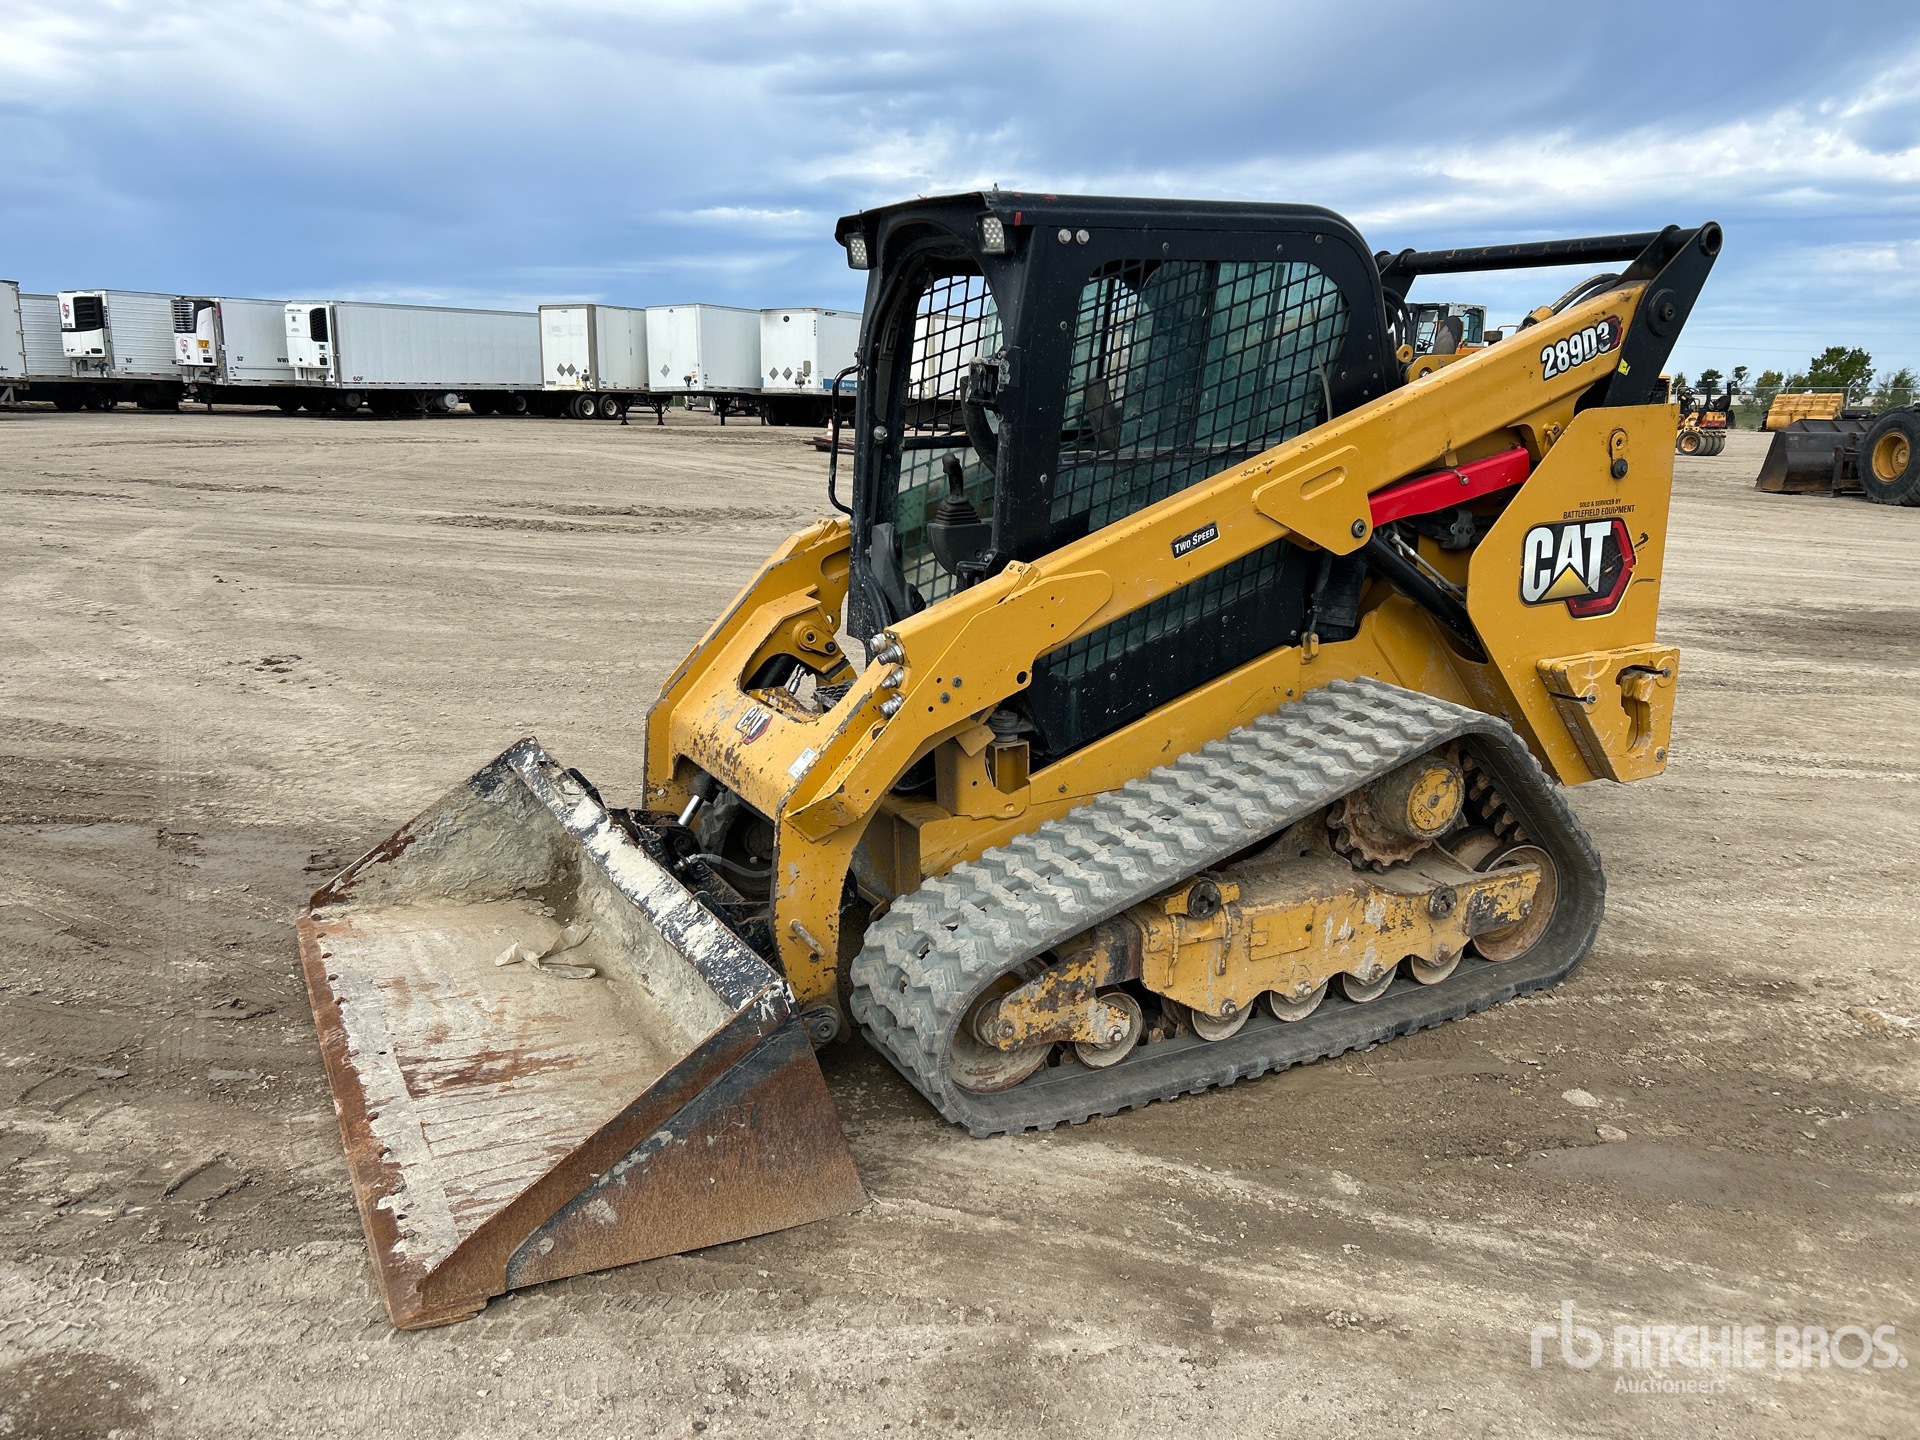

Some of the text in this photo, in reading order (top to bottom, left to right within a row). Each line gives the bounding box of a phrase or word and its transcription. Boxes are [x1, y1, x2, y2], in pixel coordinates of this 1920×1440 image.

[1542, 321, 1611, 379] 289D3
[1563, 504, 1635, 519] BATTLEFIELD EQUIPMENT
[1522, 520, 1612, 602] CAT
[735, 705, 772, 737] CAT
